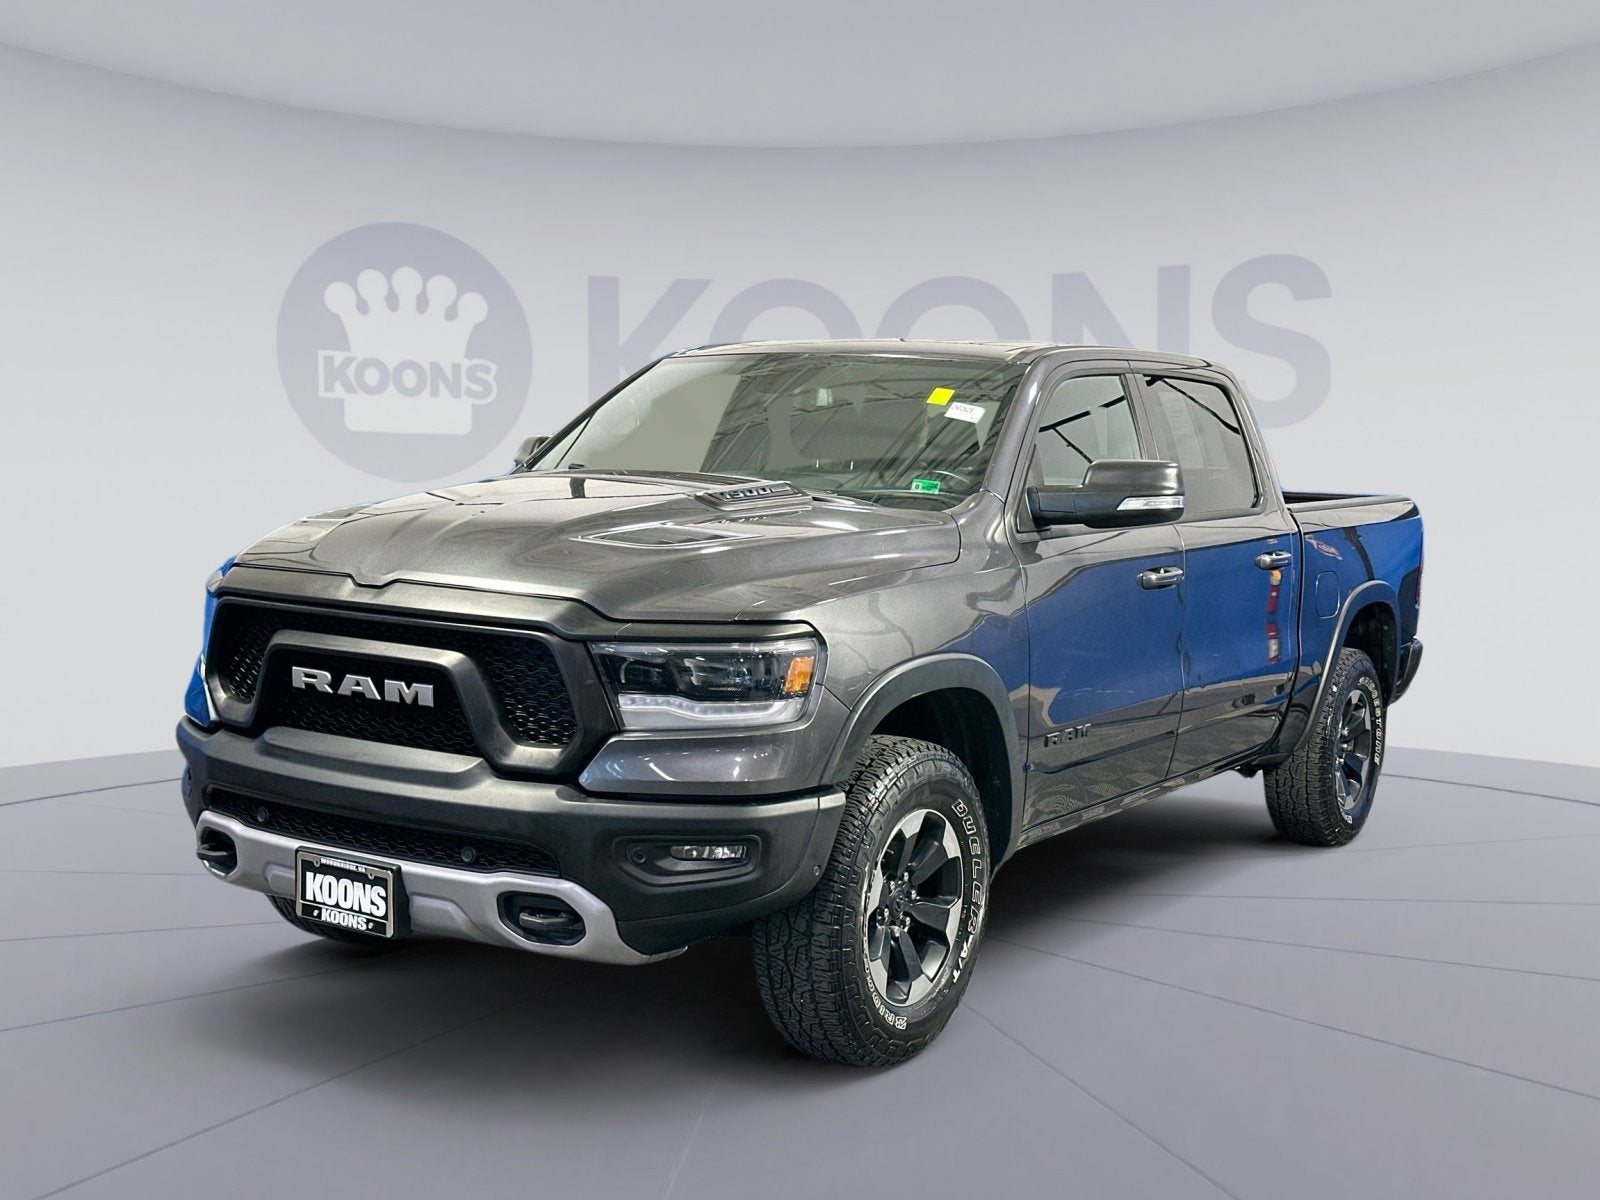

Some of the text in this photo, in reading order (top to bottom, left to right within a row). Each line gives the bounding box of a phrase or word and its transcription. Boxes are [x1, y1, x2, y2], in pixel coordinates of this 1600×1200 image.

[322, 354, 493, 401] KOONS
[292, 666, 434, 707] RAM
[1043, 723, 1092, 748] RAM
[305, 871, 387, 917] KOONS
[951, 799, 985, 984] DUELER A/T
[321, 908, 367, 931] KOONS
